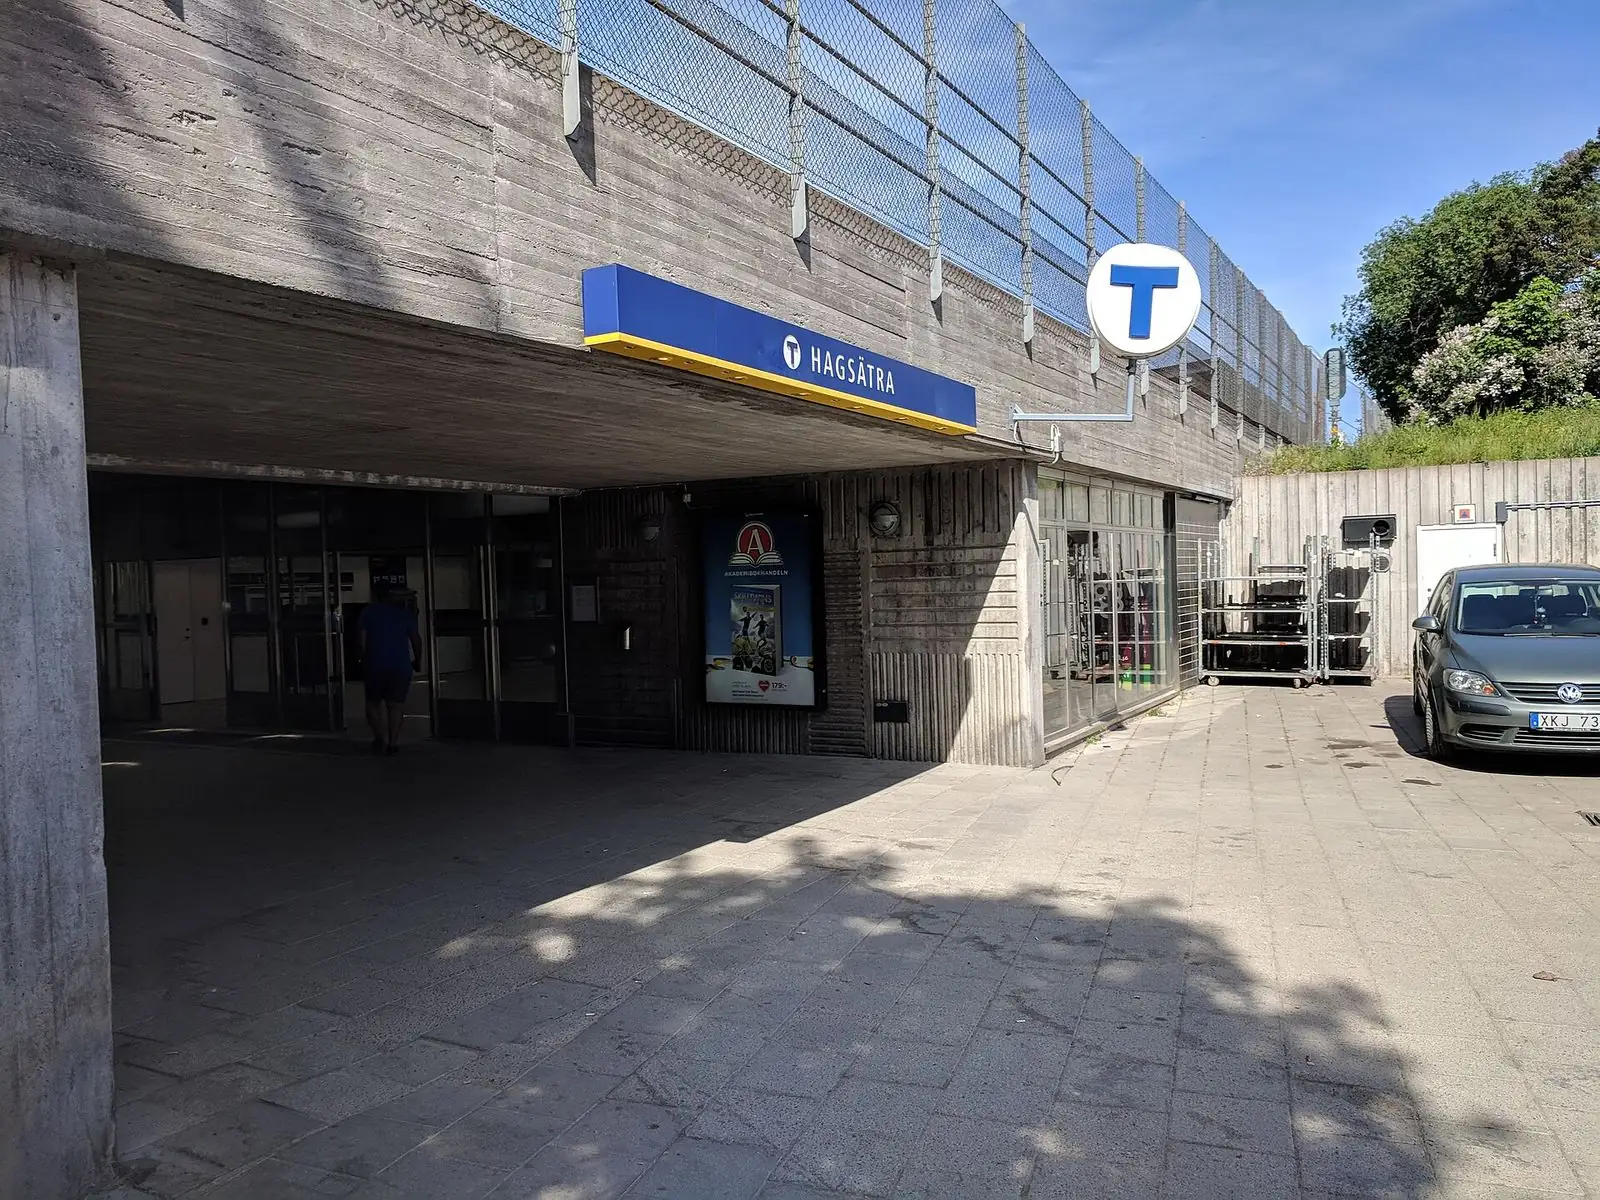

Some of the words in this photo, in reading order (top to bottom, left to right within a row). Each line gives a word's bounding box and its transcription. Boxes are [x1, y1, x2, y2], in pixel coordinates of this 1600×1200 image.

[1110, 264, 1179, 339] T
[786, 341, 798, 368] T
[811, 346, 895, 394] HAGSÄTRA
[747, 528, 765, 554] A
[1541, 715, 1569, 727] XKJ
[1580, 716, 1599, 727] 73
